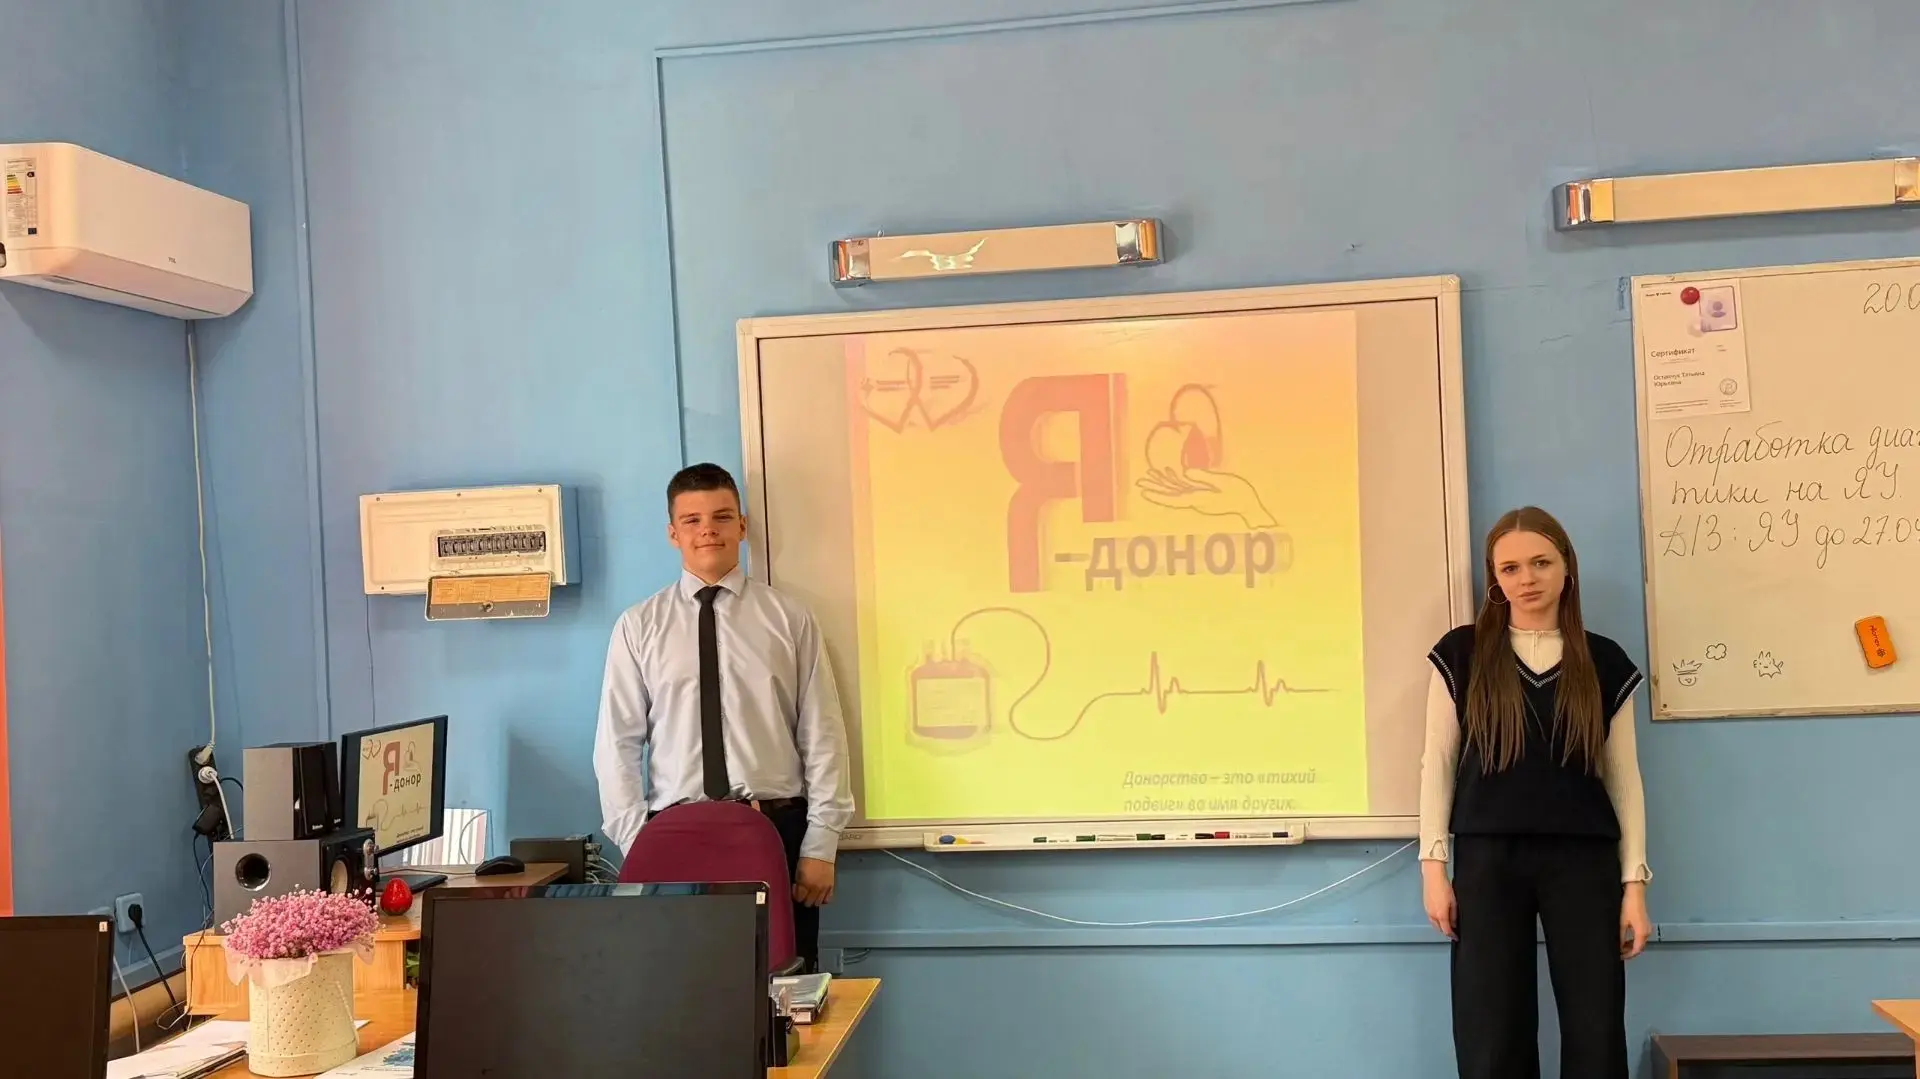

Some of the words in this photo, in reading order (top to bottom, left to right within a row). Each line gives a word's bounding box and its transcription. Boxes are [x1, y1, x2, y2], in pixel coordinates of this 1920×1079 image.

[1650, 348, 1695, 358] Сертификат
[1665, 420, 1855, 486] Отработка
[1000, 373, 1118, 593] Я
[1671, 480, 1769, 504] тики
[1785, 480, 1829, 502] на
[1749, 508, 1799, 552] ЯУ
[1815, 525, 1846, 569] до
[382, 741, 401, 796] Я
[1123, 771, 1207, 788] Донорство
[1222, 772, 1254, 786] это
[1188, 801, 1205, 812] во
[1209, 799, 1238, 811] имя
